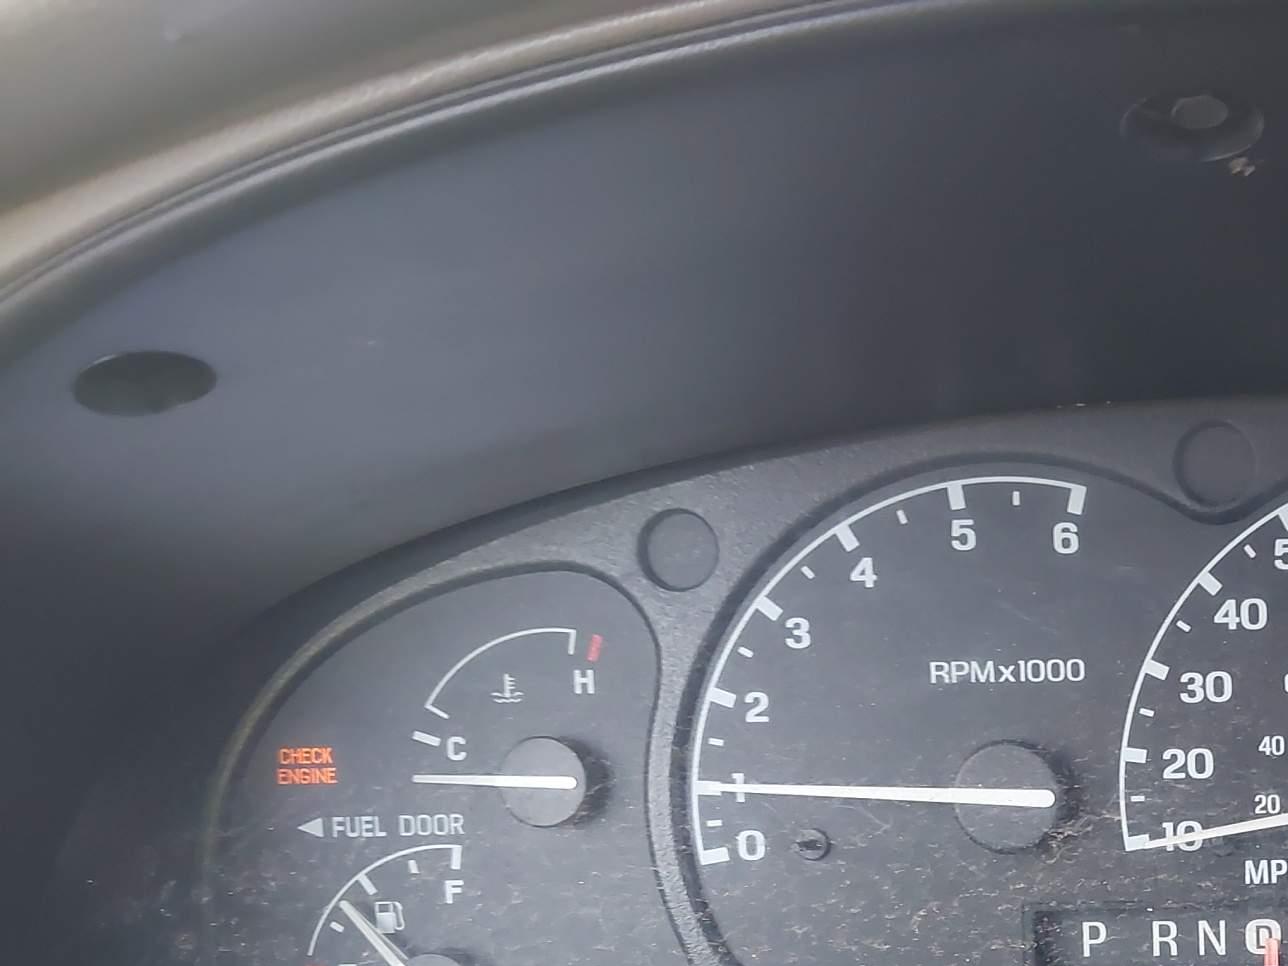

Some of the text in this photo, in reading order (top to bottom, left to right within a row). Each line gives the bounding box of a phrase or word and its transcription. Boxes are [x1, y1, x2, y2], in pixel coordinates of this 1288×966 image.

[951, 519, 977, 551] 5
[1053, 522, 1079, 554] 6
[850, 557, 877, 588] 4
[1214, 598, 1267, 630] 40
[785, 617, 811, 649] 3
[573, 669, 595, 694] H
[929, 658, 1086, 685] RPMx1000
[1179, 671, 1233, 703] 30
[745, 692, 769, 722] 2
[278, 746, 334, 765] CHECK
[446, 736, 467, 761] C
[1258, 735, 1285, 756] 40
[277, 768, 338, 786] ENGINE
[1162, 748, 1214, 779] 20
[731, 772, 745, 802] 1
[1254, 795, 1281, 814] 20
[331, 814, 465, 838] FUEL DOOR
[736, 831, 766, 861] 0
[445, 880, 464, 904] F
[1082, 921, 1108, 957] P
[1152, 920, 1178, 956] R
[1199, 920, 1226, 955] N
